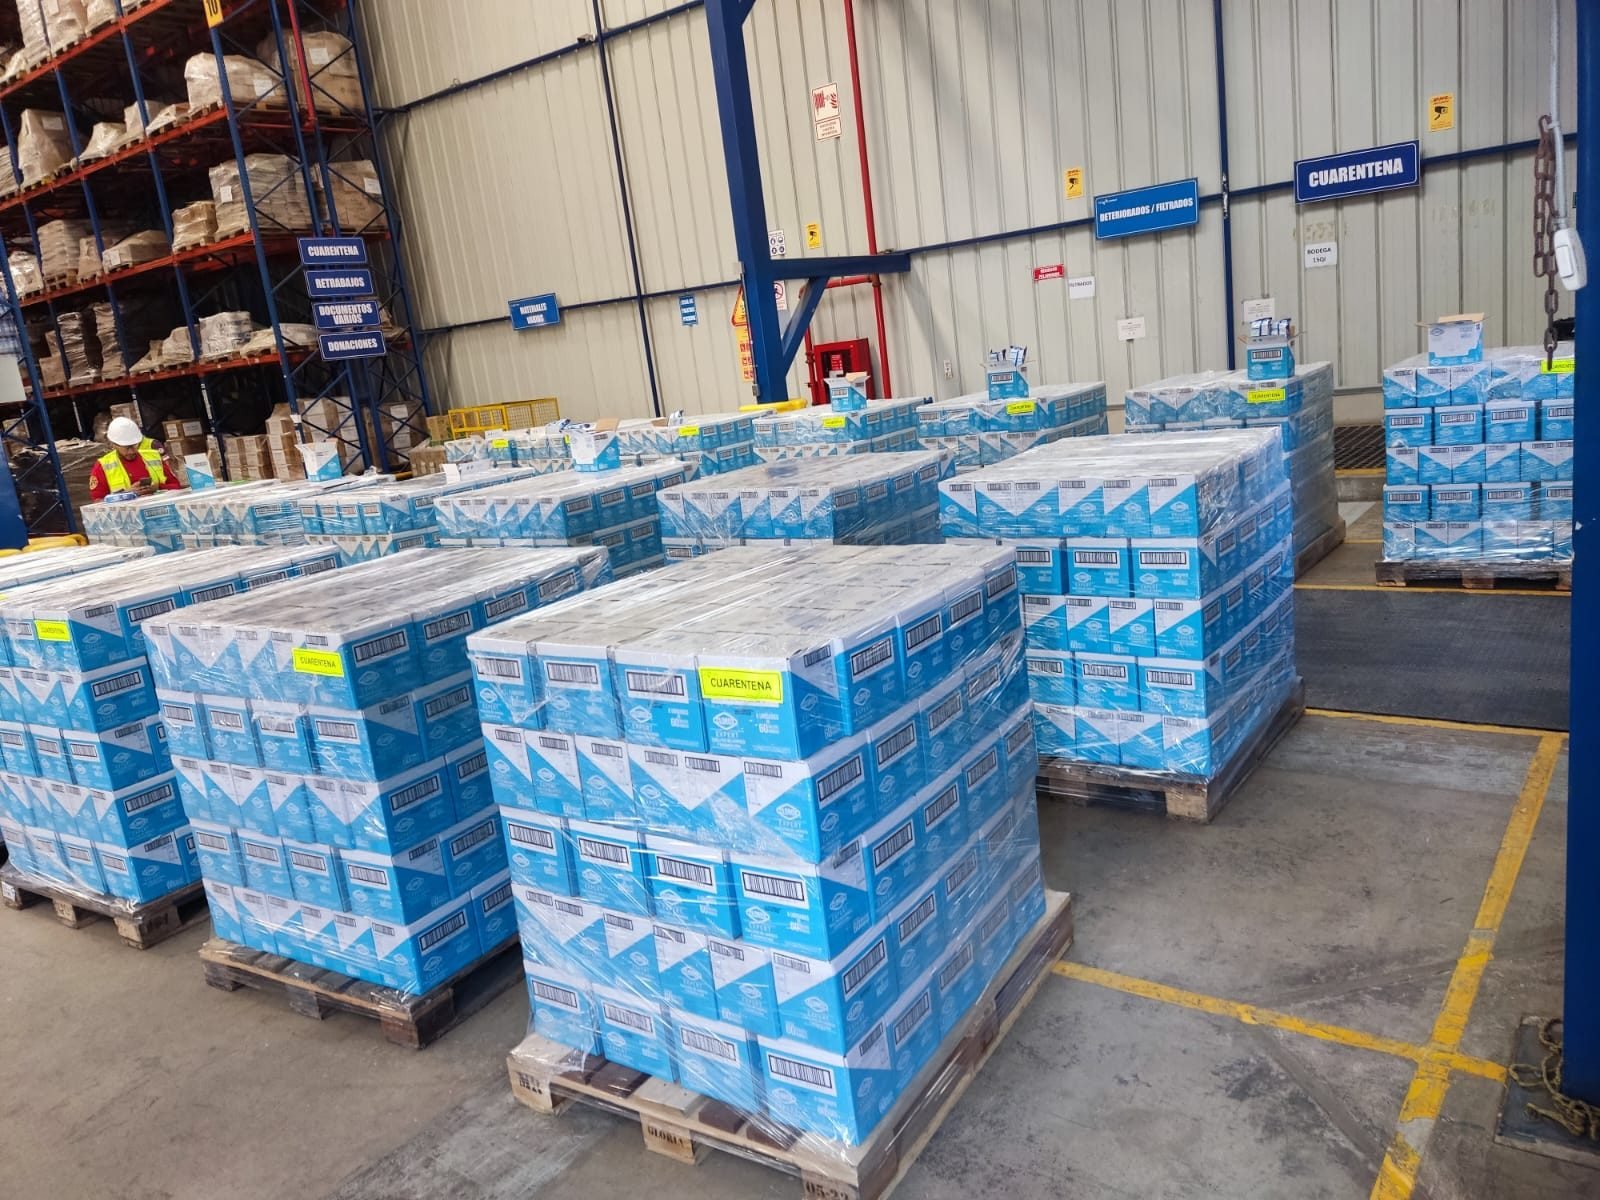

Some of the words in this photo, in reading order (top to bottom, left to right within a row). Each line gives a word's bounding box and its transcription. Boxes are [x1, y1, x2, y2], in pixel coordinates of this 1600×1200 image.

[1309, 157, 1404, 188] CUARENTENA
[1100, 205, 1151, 222] DETERIORADOS
[1155, 197, 1194, 212] FILTRADOS
[307, 245, 360, 257] CUARENTENA
[1307, 247, 1331, 255] BODEGA
[315, 277, 366, 289] RETRABAJOS
[318, 303, 373, 316] DOCUMENTOS
[333, 313, 363, 325] VARIOS
[327, 338, 378, 352] DONACIONES
[299, 656, 337, 668] CUARENTENA
[710, 678, 773, 691] CUARENTENA
